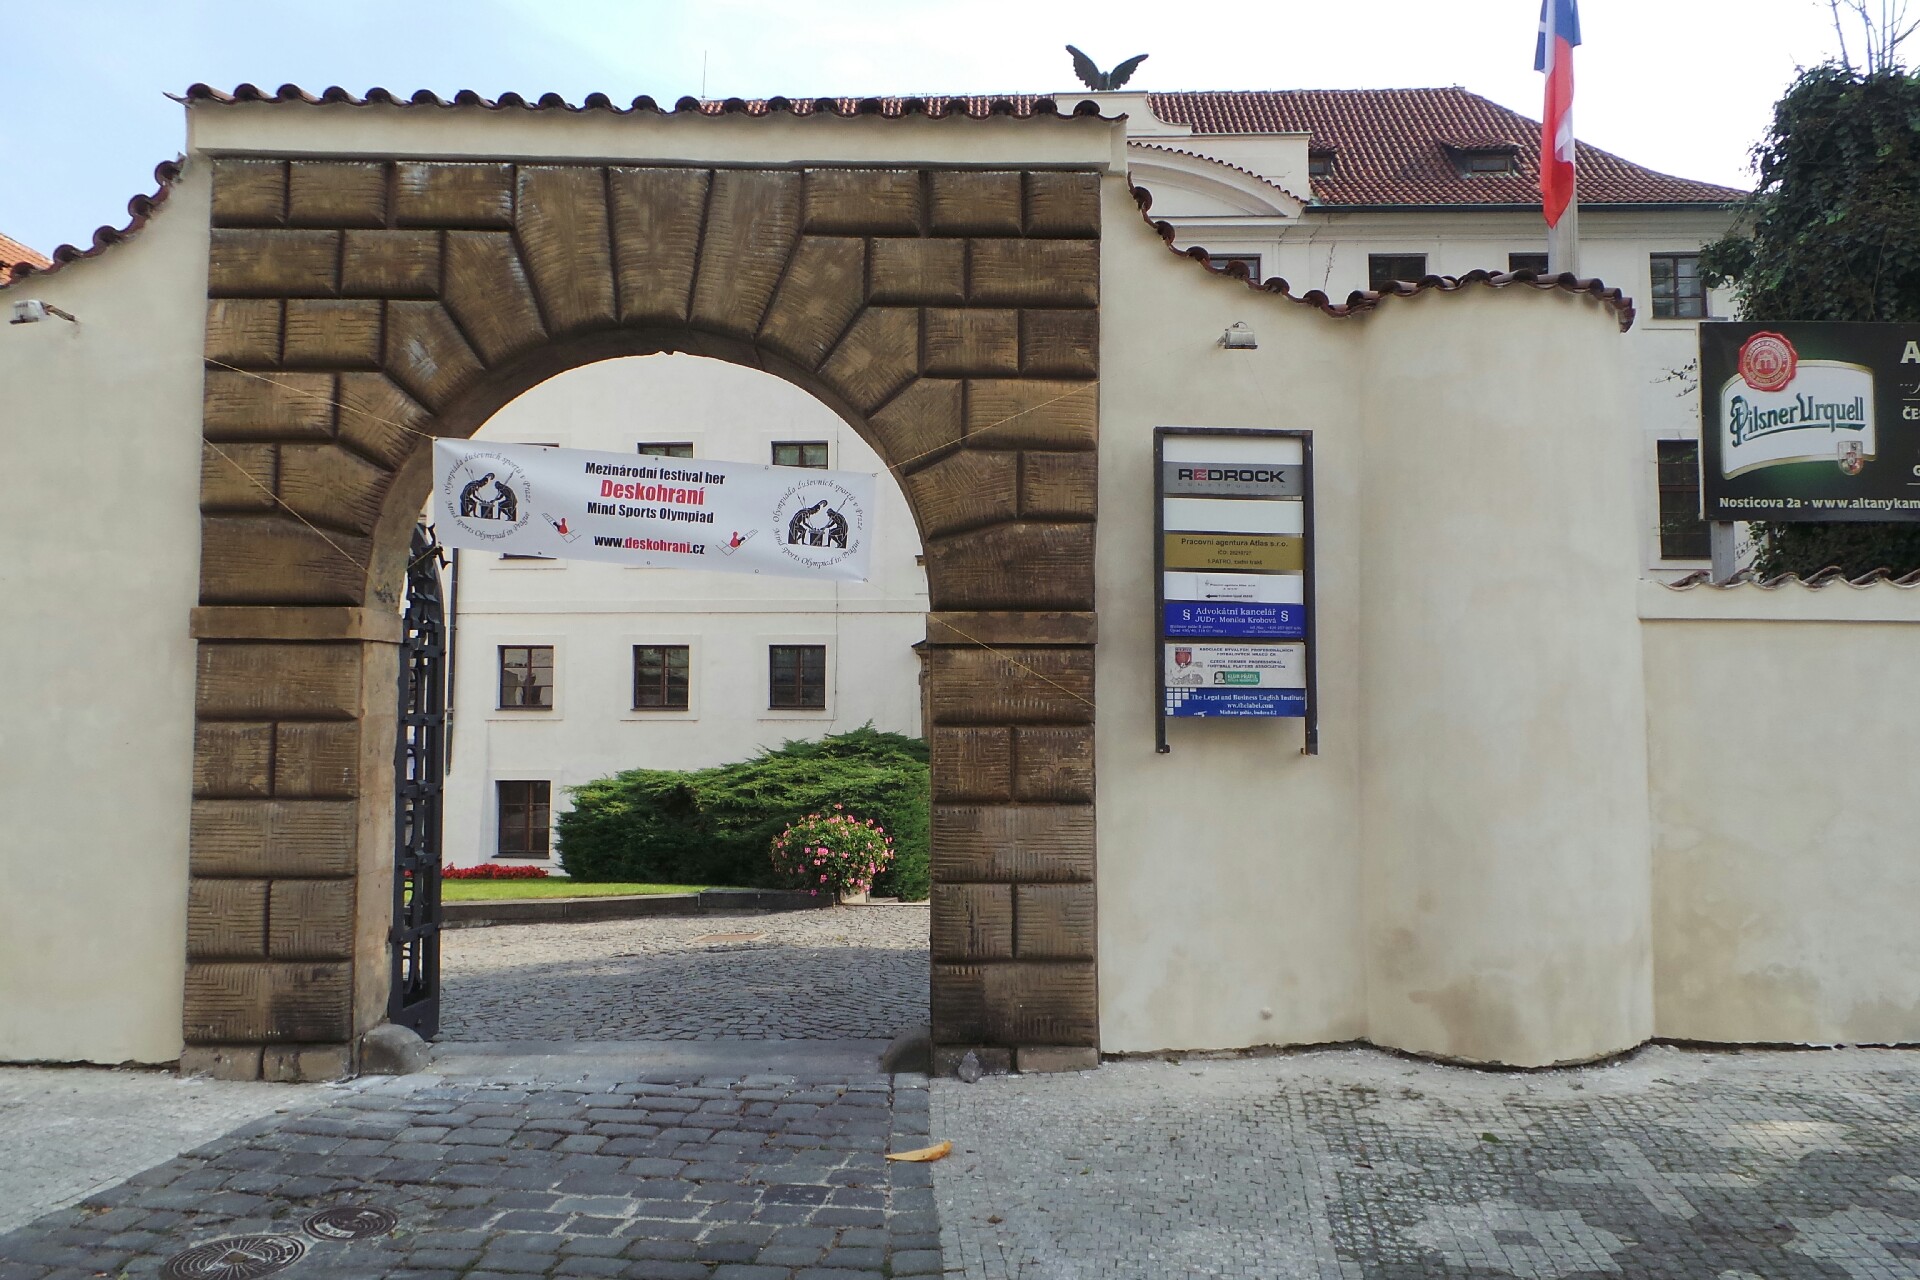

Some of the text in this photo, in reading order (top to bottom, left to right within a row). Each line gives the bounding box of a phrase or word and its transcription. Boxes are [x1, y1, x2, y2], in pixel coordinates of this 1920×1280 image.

[1730, 392, 1864, 447] Pilsner Urquell
[1903, 406, 1920, 420] ČE
[585, 462, 726, 485] Mezinárodní festival her
[1178, 469, 1285, 483] REDROCK
[600, 479, 705, 506] Deskohraní
[1719, 497, 1784, 508] Nosticova
[1786, 498, 1802, 508] 2a
[587, 502, 714, 524] Mind Sports Olympiad
[594, 536, 705, 555] www.deskohrani.cz
[1215, 539, 1249, 547] agentura
[1249, 539, 1269, 548] Atlas
[1196, 607, 1239, 616] Advokátní
[1240, 608, 1276, 616] kancelář
[1247, 617, 1276, 625] Krobová
